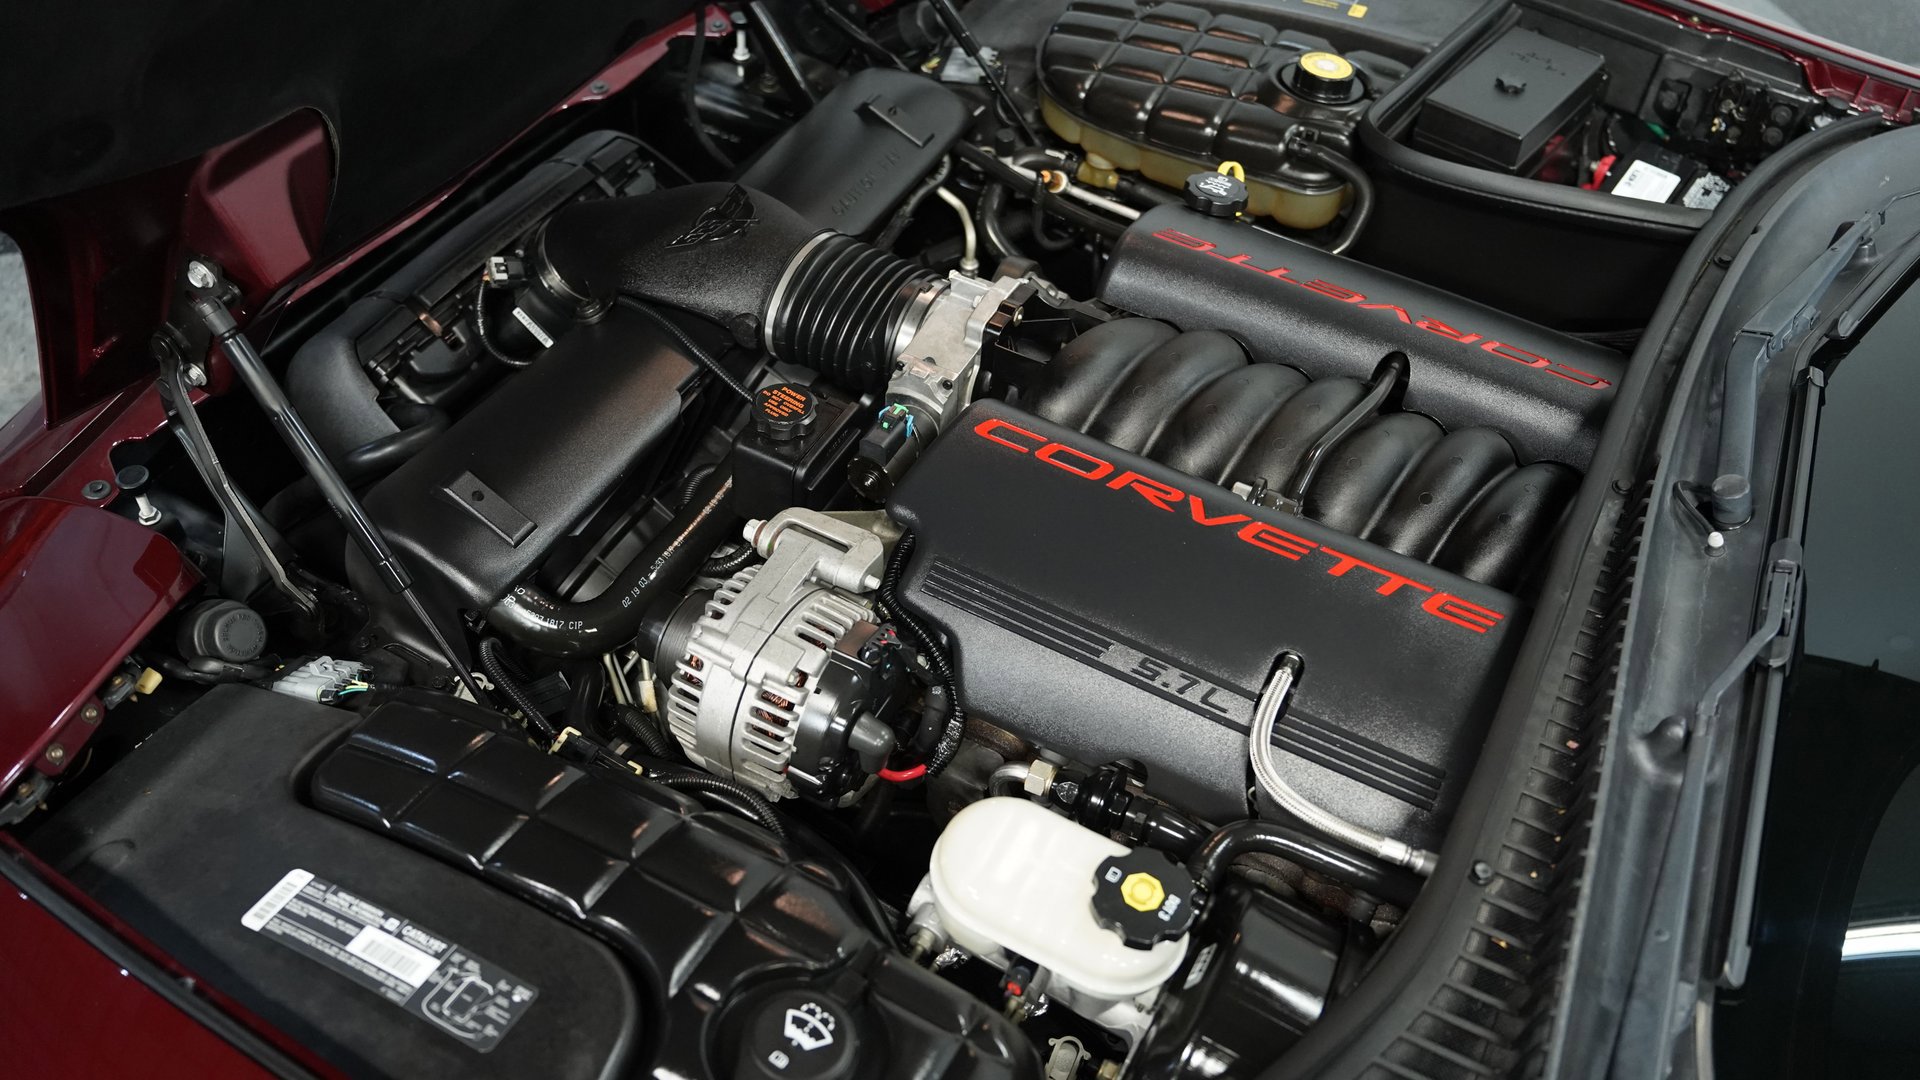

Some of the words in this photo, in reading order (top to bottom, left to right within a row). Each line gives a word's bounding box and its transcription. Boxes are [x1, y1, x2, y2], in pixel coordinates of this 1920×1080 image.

[1152, 229, 1612, 389] CORVETTE
[772, 389, 805, 409] STEERING
[782, 386, 806, 402] POWER
[763, 402, 789, 417] APPROVED
[765, 408, 779, 417] FLUID
[771, 394, 782, 402] NOT
[783, 401, 805, 415] OVERFILL
[973, 417, 1505, 633] CORVETTE
[622, 596, 632, 608] 02
[630, 586, 641, 598] 19
[638, 576, 648, 588] 03
[568, 620, 583, 630] CIP
[1130, 657, 1228, 713] 5.7L
